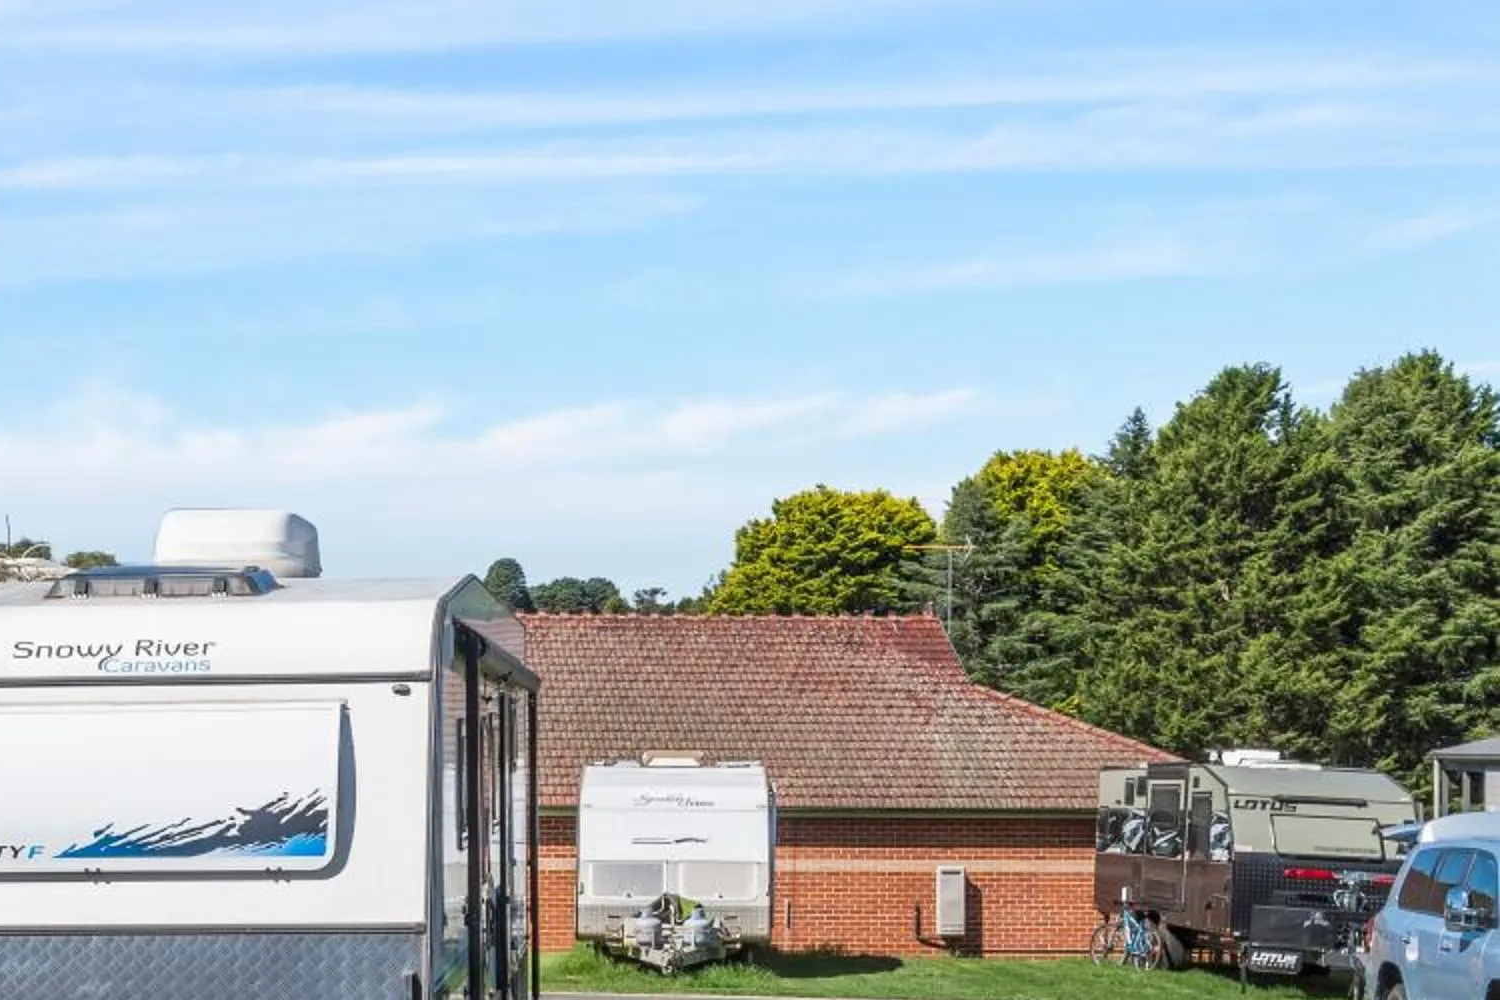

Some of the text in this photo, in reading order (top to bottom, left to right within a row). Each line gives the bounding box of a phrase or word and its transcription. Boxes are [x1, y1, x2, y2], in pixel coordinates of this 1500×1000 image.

[12, 639, 216, 670] Snowy River
[103, 658, 211, 673] Caravans
[1234, 799, 1297, 812] LOTUS
